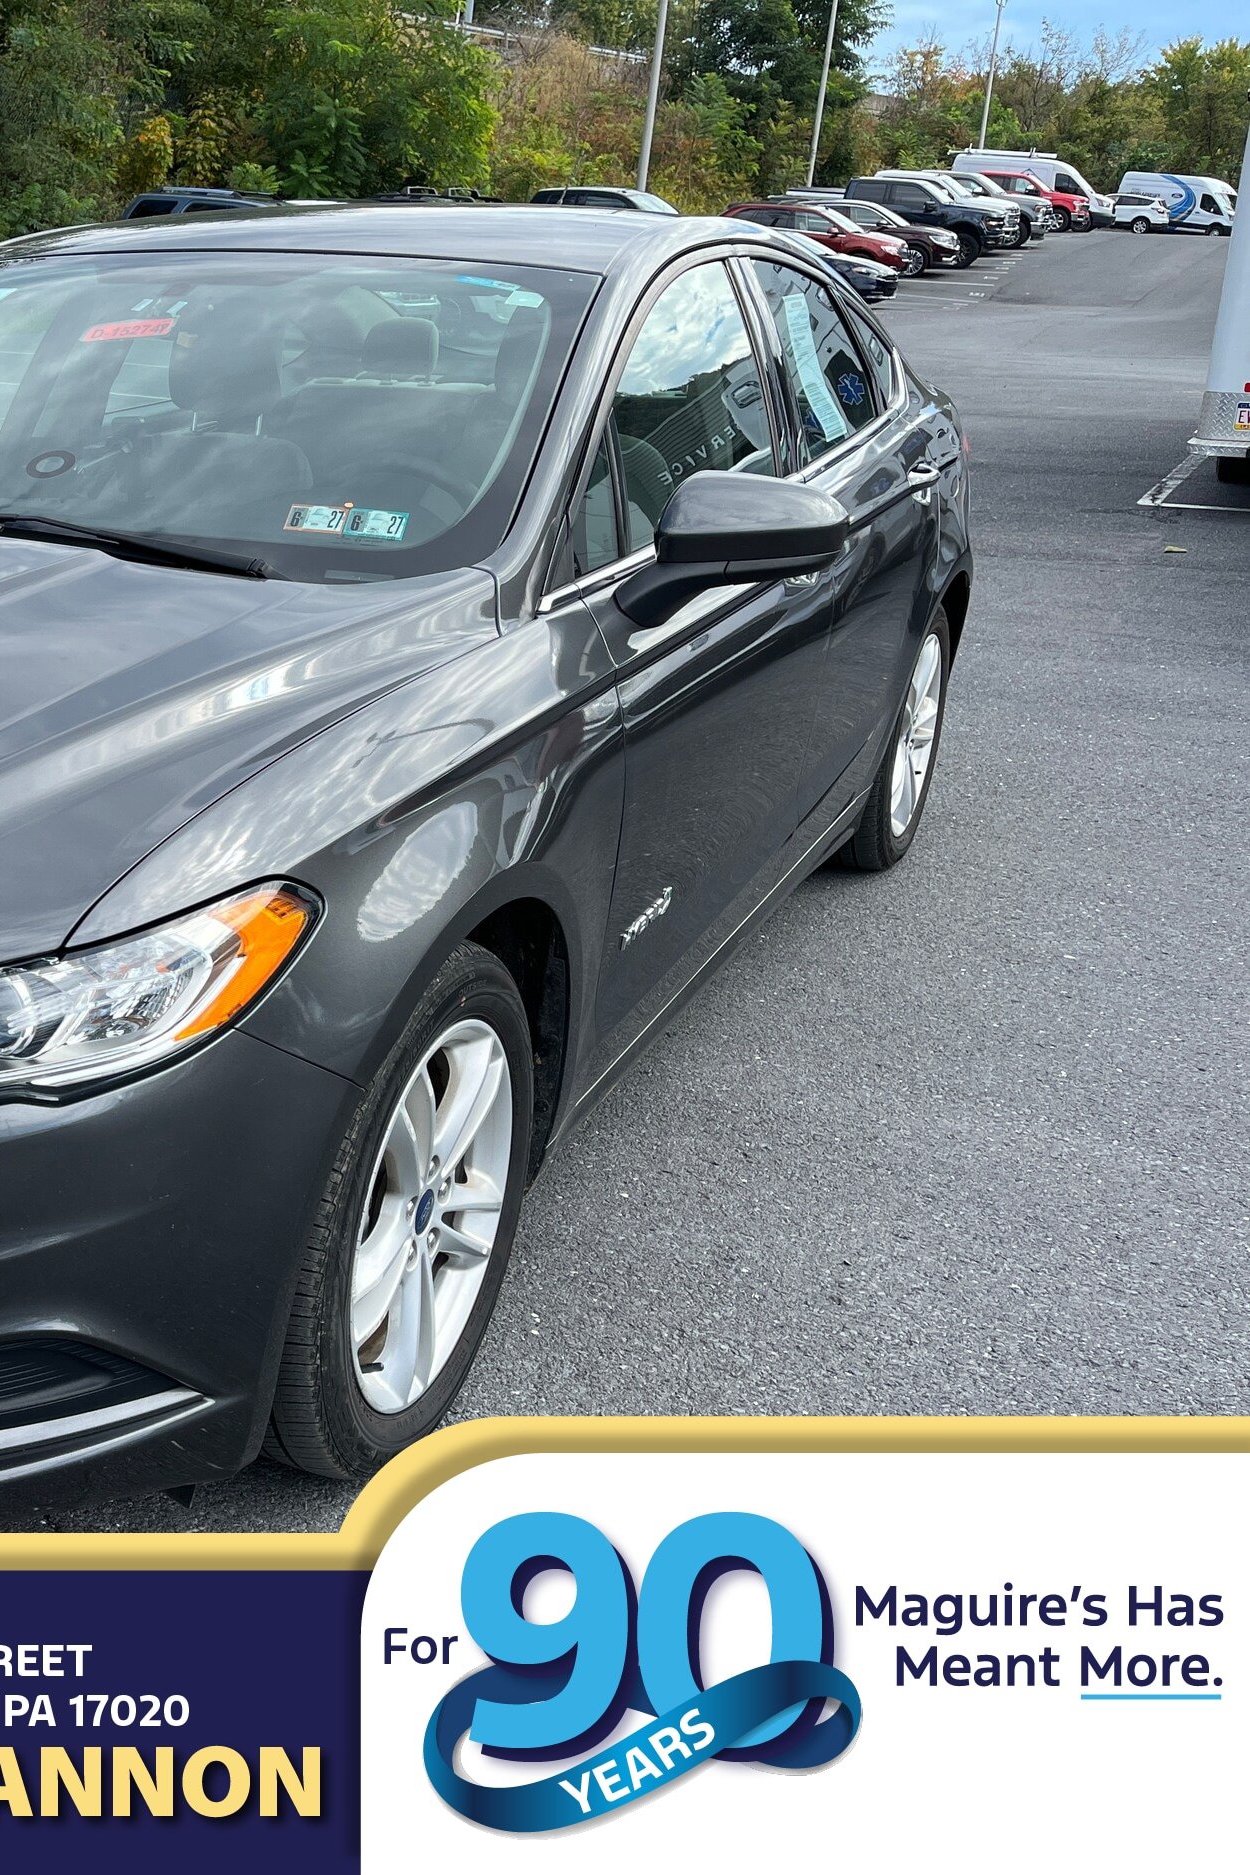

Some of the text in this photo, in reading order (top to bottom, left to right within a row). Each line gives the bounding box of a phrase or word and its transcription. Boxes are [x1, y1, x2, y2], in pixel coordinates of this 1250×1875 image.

[290, 510, 345, 530] 6 27
[350, 515, 404, 535] 6 27
